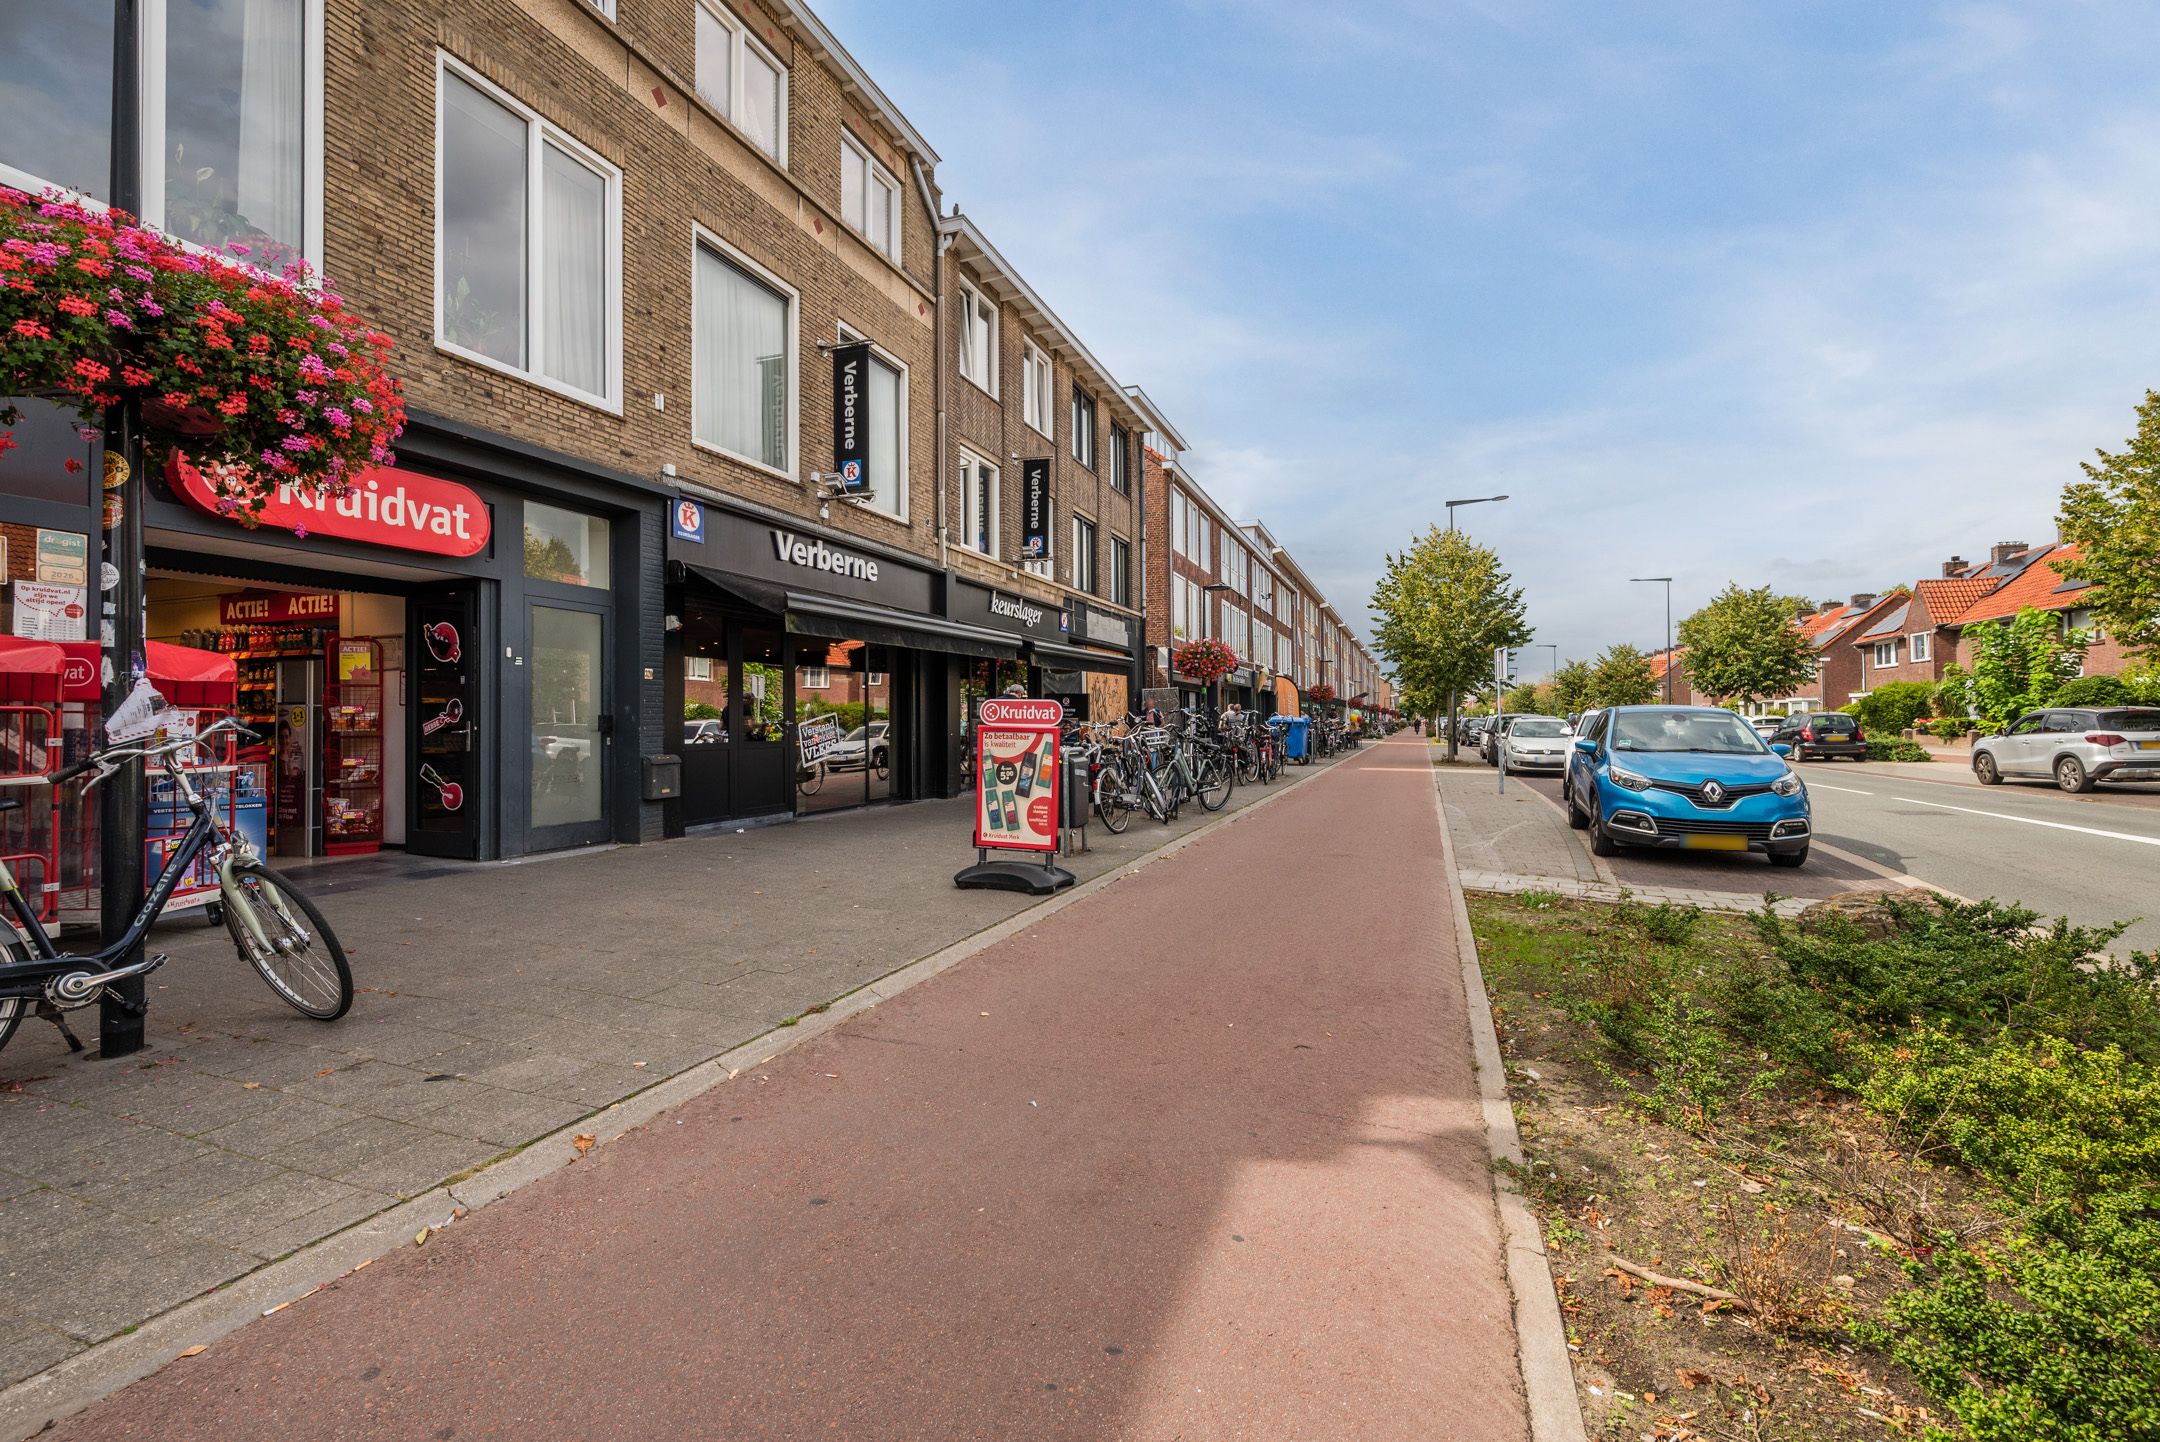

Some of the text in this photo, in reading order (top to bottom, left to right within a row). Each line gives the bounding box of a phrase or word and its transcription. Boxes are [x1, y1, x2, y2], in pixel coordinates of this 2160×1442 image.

[844, 361, 858, 450] Verberne
[1031, 469, 1041, 529] Verberne
[775, 530, 879, 582] Verberne
[26, 597, 45, 605] altijd
[32, 586, 71, 595] kruidvat.nl
[226, 595, 334, 620] ACTIE! ACTIE!
[990, 590, 1043, 627] keurslager
[1001, 705, 1056, 720] Kruidvat
[802, 719, 835, 738] Verstand
[994, 732, 1030, 740] betaalbaar
[134, 863, 177, 927] Gazelle
